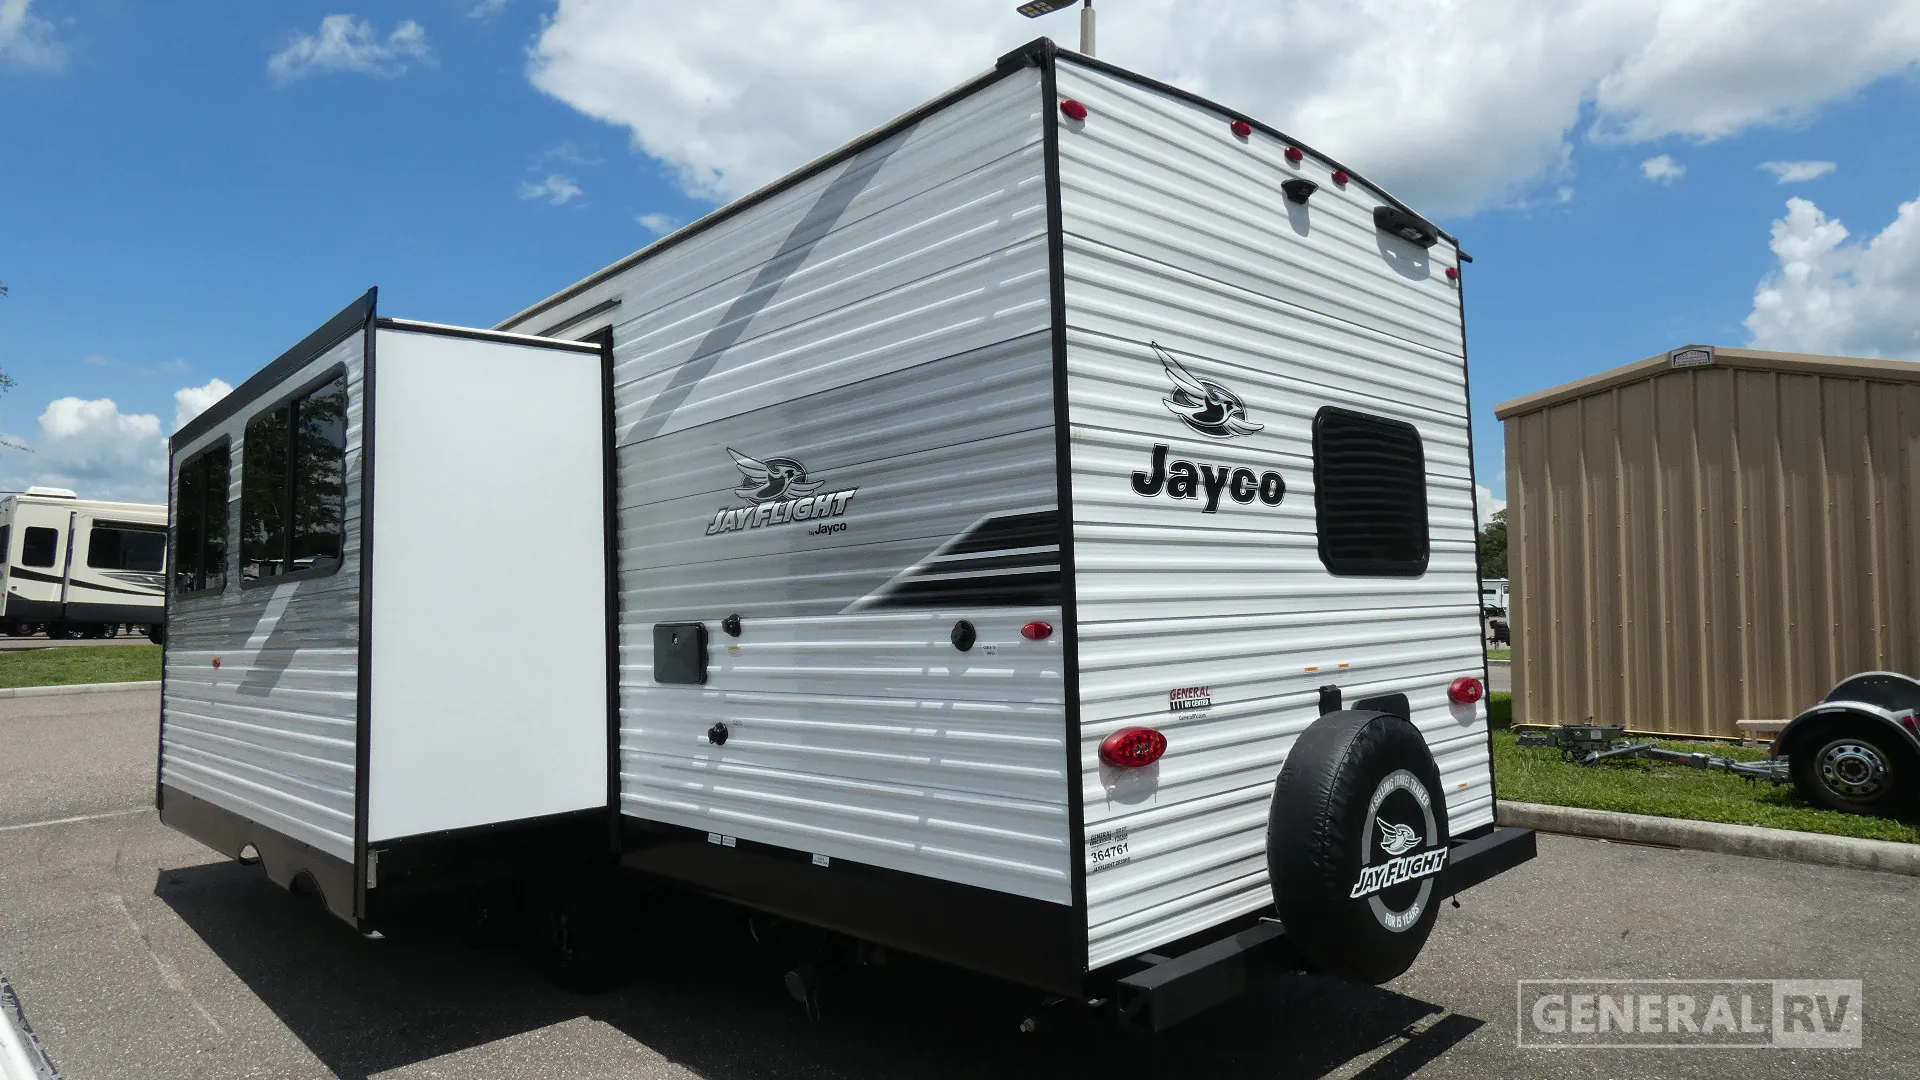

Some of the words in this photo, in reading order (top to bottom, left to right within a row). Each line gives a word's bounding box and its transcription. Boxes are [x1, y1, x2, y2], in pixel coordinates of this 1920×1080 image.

[1130, 442, 1286, 514] Jayco
[815, 522, 847, 536] Jayco
[1170, 686, 1211, 700] GENERAL
[1373, 778, 1394, 807] SELLING
[1410, 778, 1430, 808] TRAILER
[1090, 842, 1129, 863] 364761
[1385, 912, 1396, 928] FOR
[1402, 902, 1420, 926] YEARS
